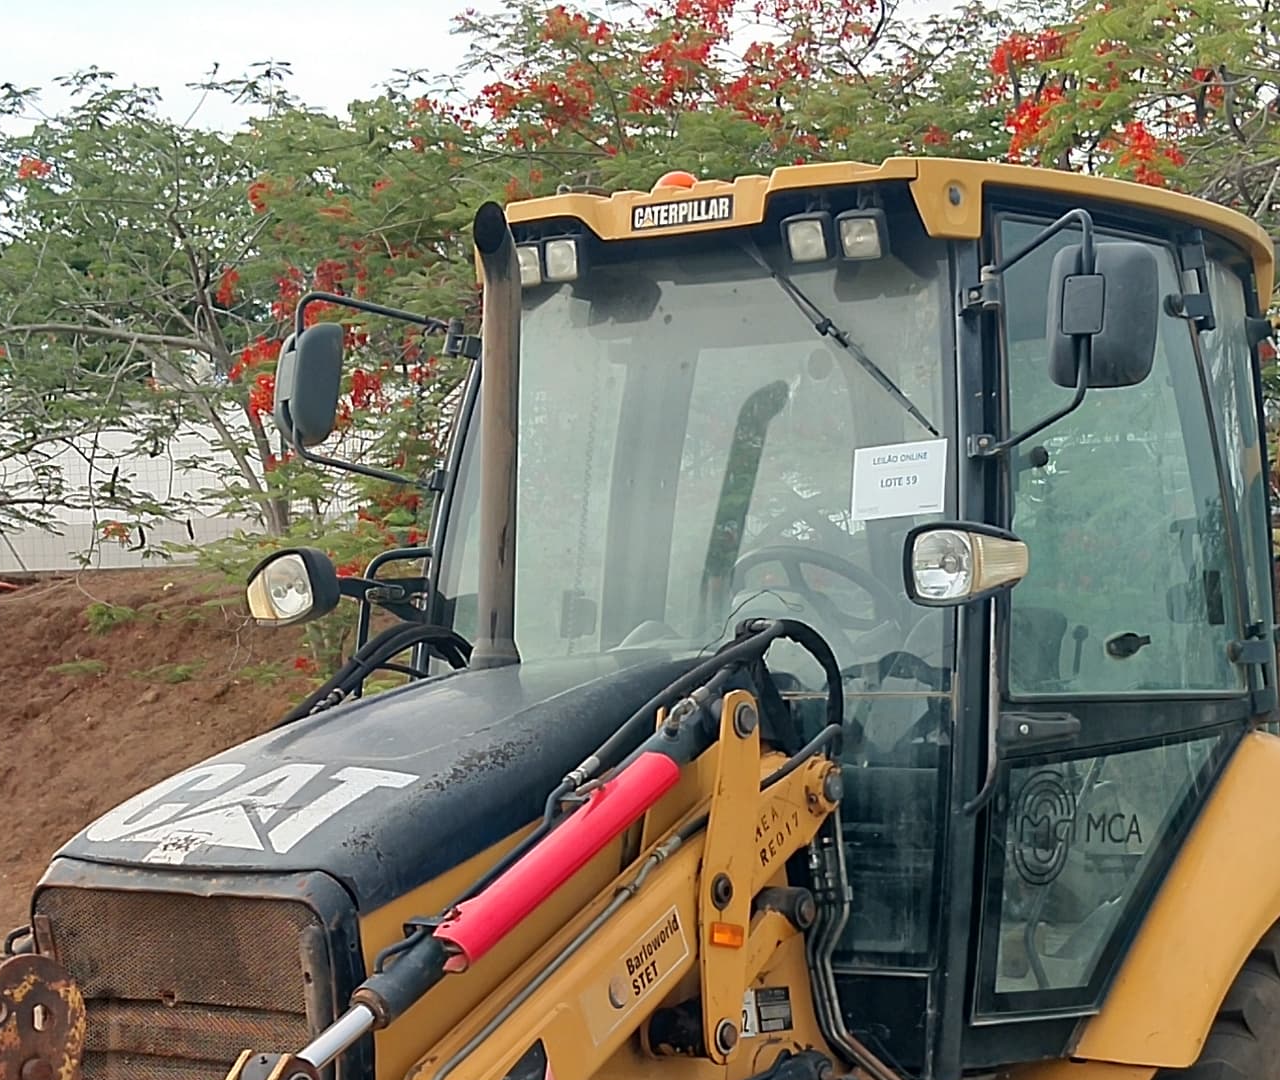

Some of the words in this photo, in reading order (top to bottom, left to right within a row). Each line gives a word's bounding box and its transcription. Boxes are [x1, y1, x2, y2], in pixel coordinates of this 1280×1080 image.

[634, 198, 730, 228] CATERPILLAR
[900, 452, 928, 461] ONLINE
[880, 477, 903, 488] LOTE
[86, 763, 420, 854] CAT
[1086, 813, 1142, 843] MCA
[626, 914, 680, 976] Barloworld
[632, 960, 658, 996] STET
